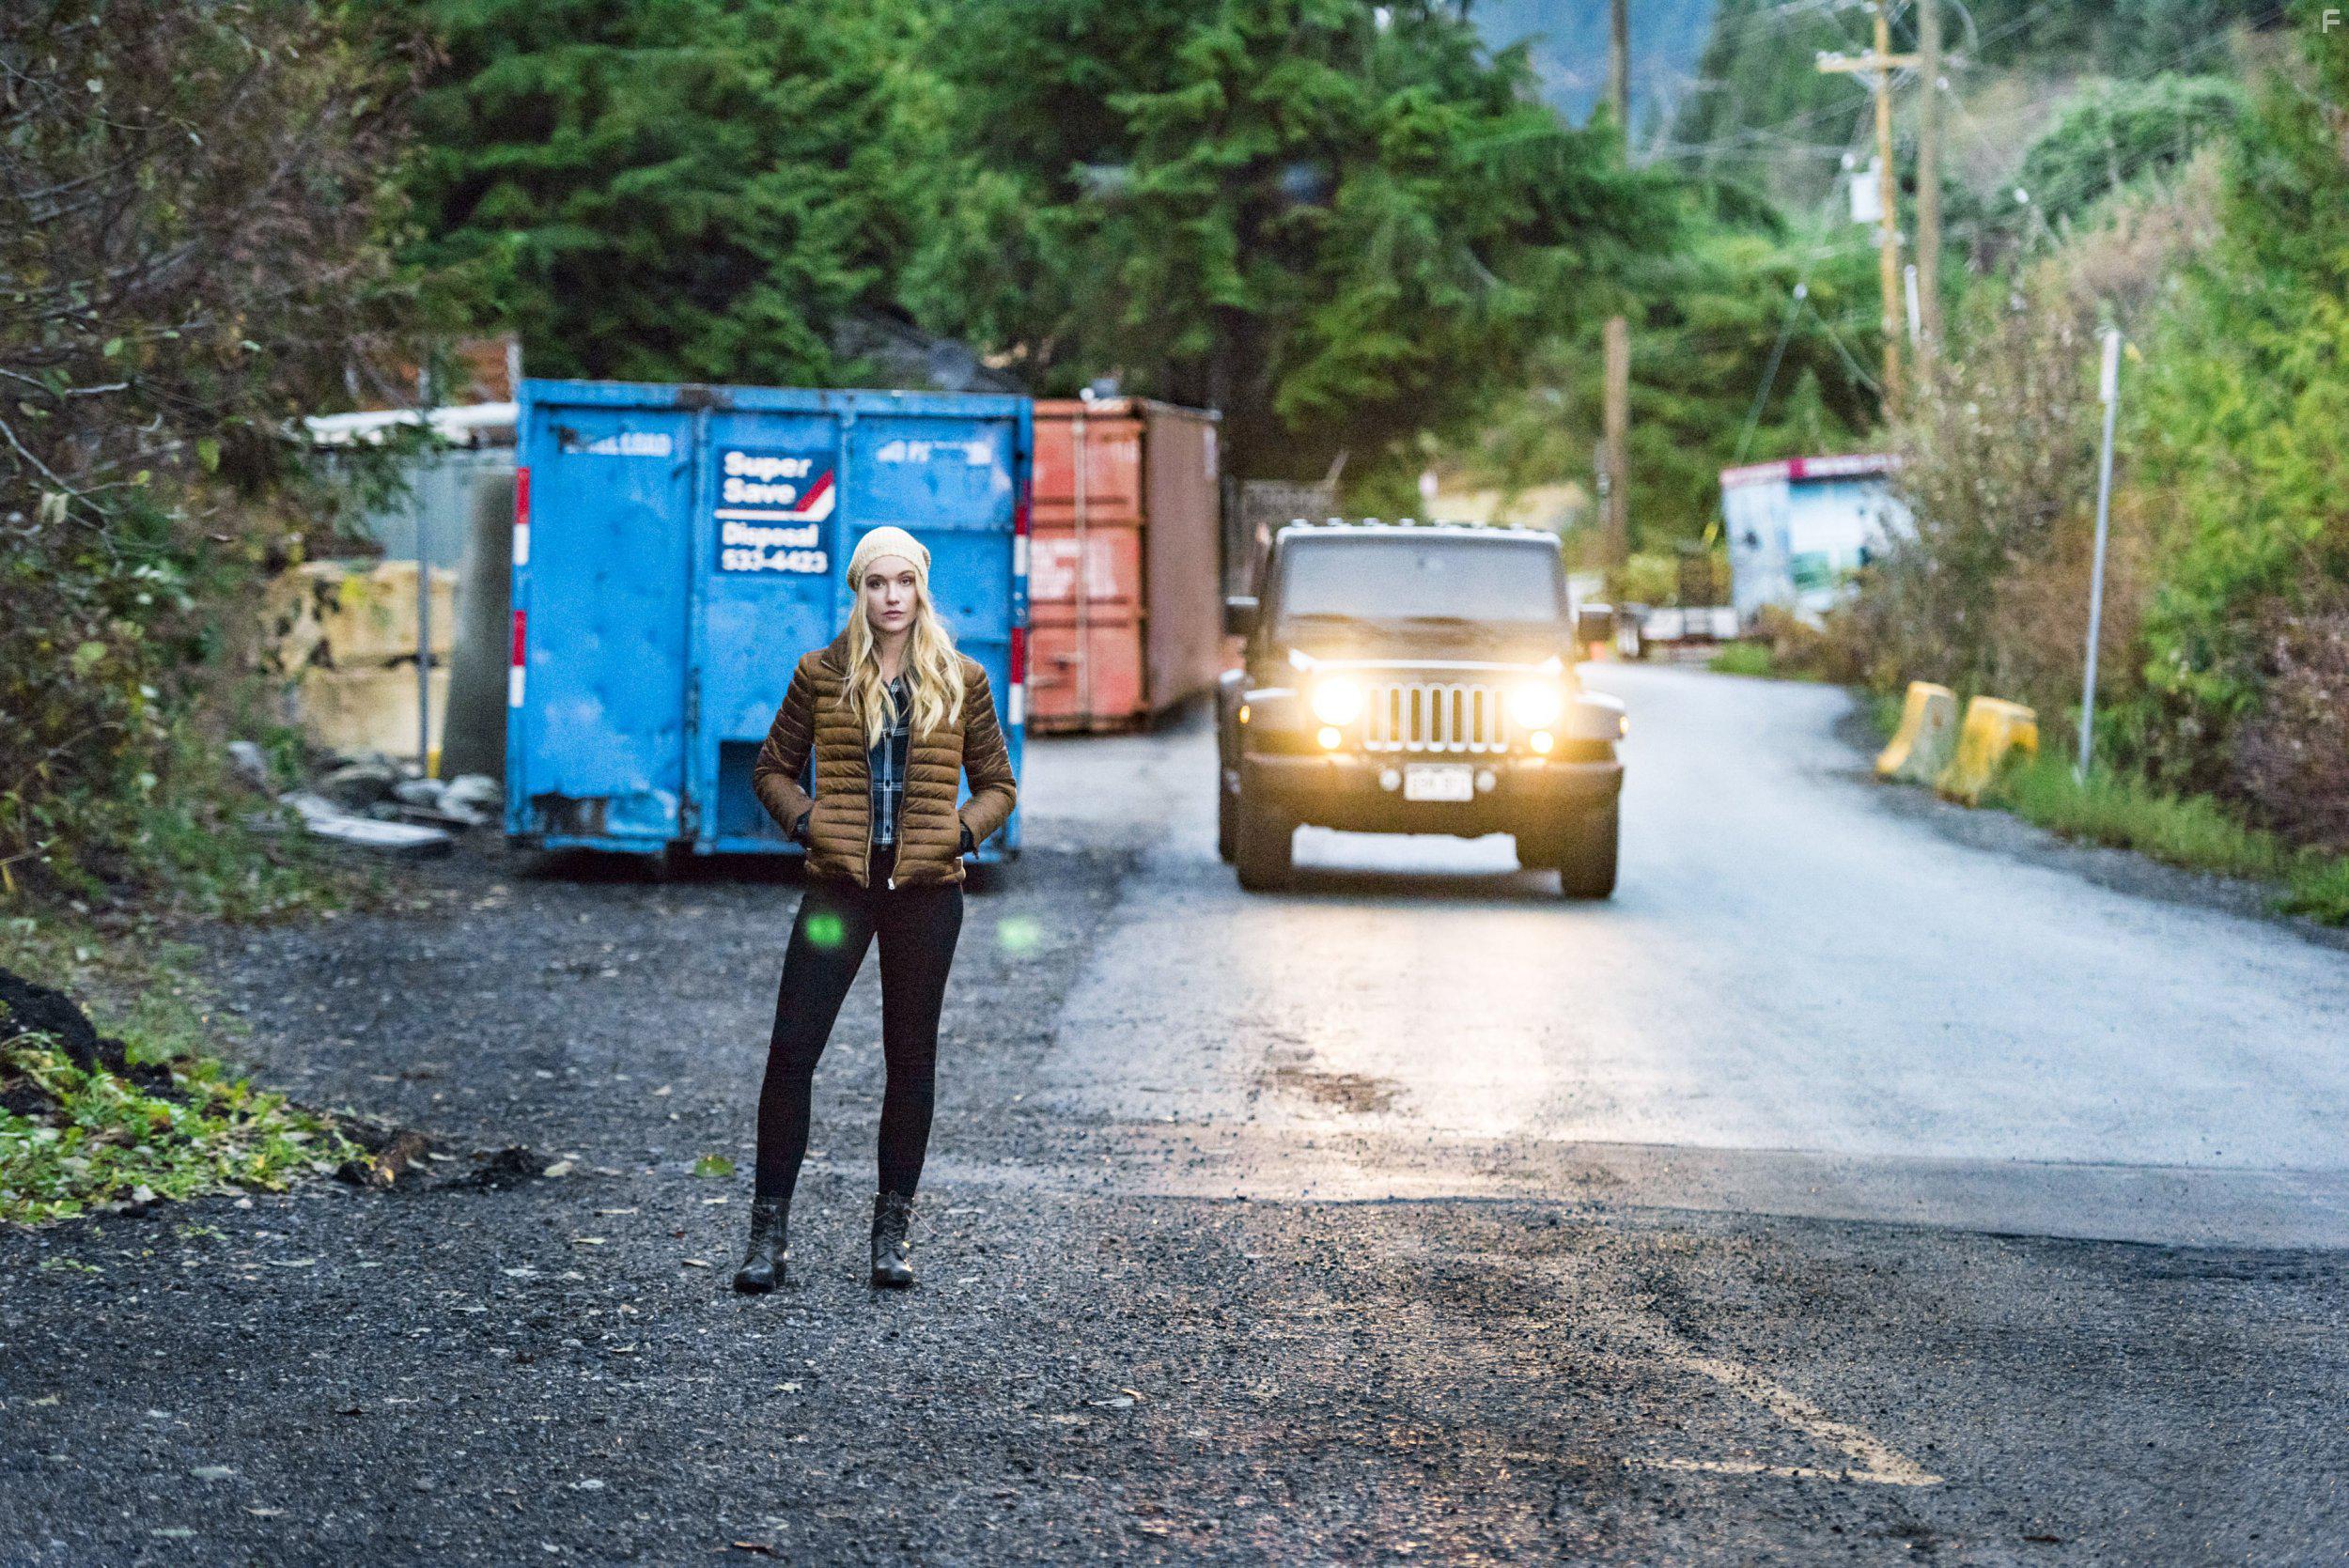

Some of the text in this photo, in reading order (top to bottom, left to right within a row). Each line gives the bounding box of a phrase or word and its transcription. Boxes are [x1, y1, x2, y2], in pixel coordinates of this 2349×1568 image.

[723, 451, 813, 482] Super
[723, 477, 796, 505] Save
[722, 520, 818, 549] Disposal
